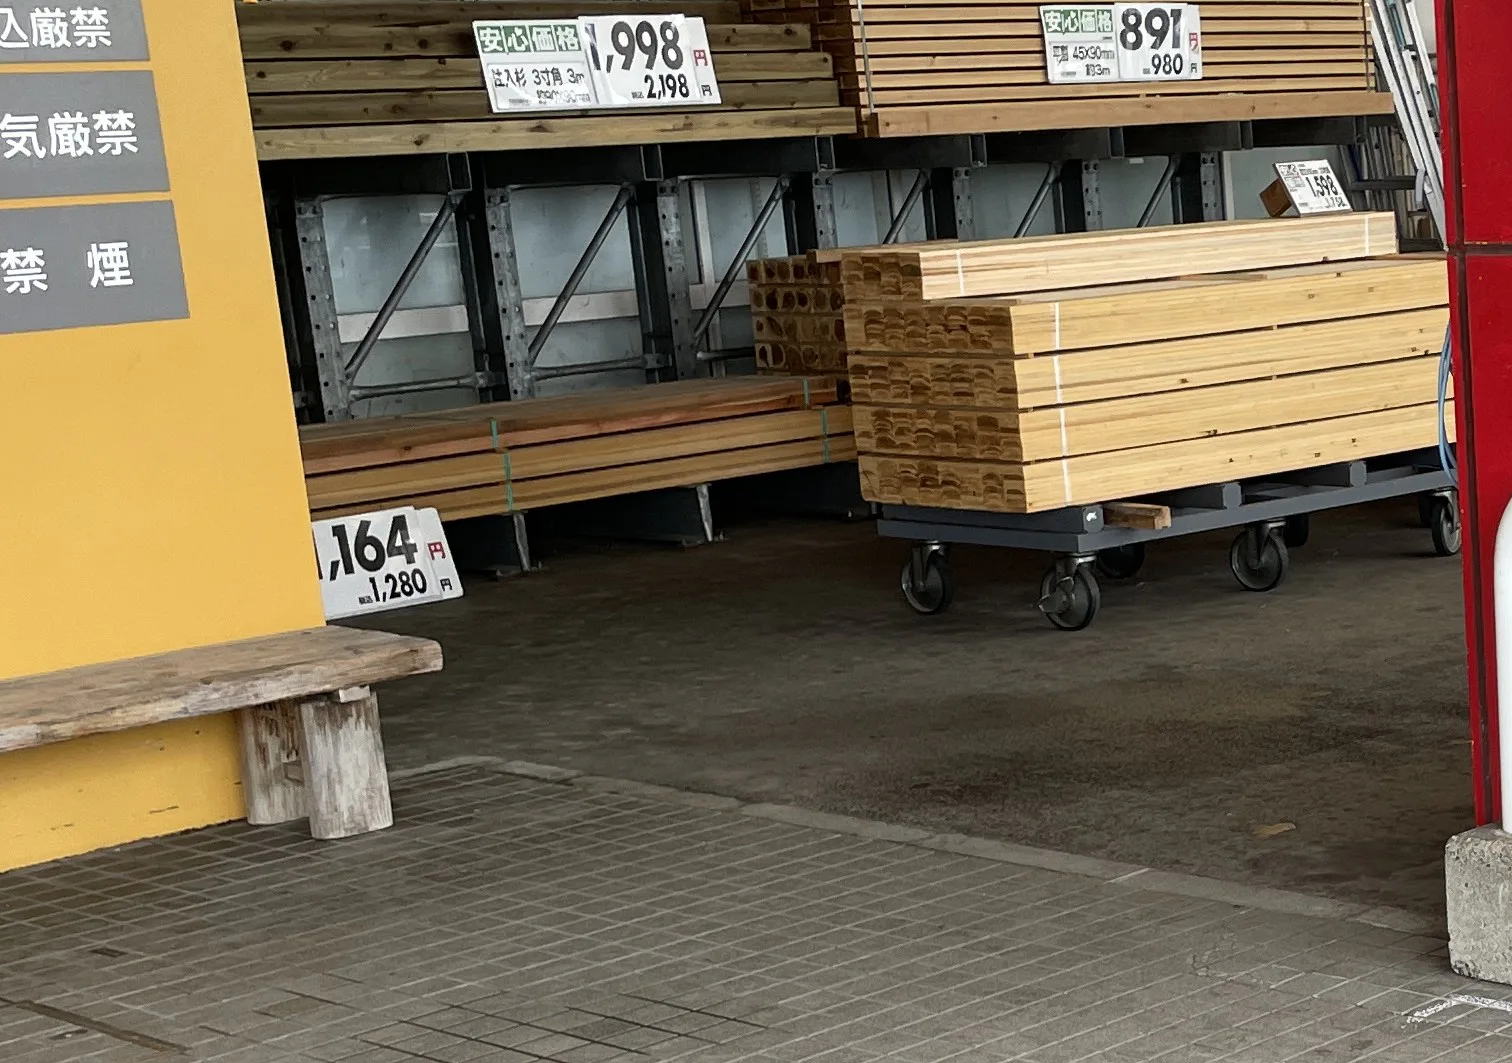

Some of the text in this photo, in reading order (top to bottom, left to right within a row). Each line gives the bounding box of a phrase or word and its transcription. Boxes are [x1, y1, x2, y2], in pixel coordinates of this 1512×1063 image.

[1044, 10, 1113, 34] 安心価格
[1120, 8, 1183, 51] 891
[478, 26, 580, 52] 安心価格
[585, 20, 709, 73] 1,998 円
[1151, 53, 1198, 75] 980 円
[491, 67, 527, 88] 注入杉
[531, 67, 563, 87] 3寸角
[645, 74, 690, 100] 2,198
[701, 84, 713, 97] 円
[0, 110, 139, 159] 気厳禁
[1305, 174, 1339, 197] 1,598
[427, 541, 447, 561] 円
[368, 567, 427, 603] 1,280
[439, 577, 453, 592] 円
